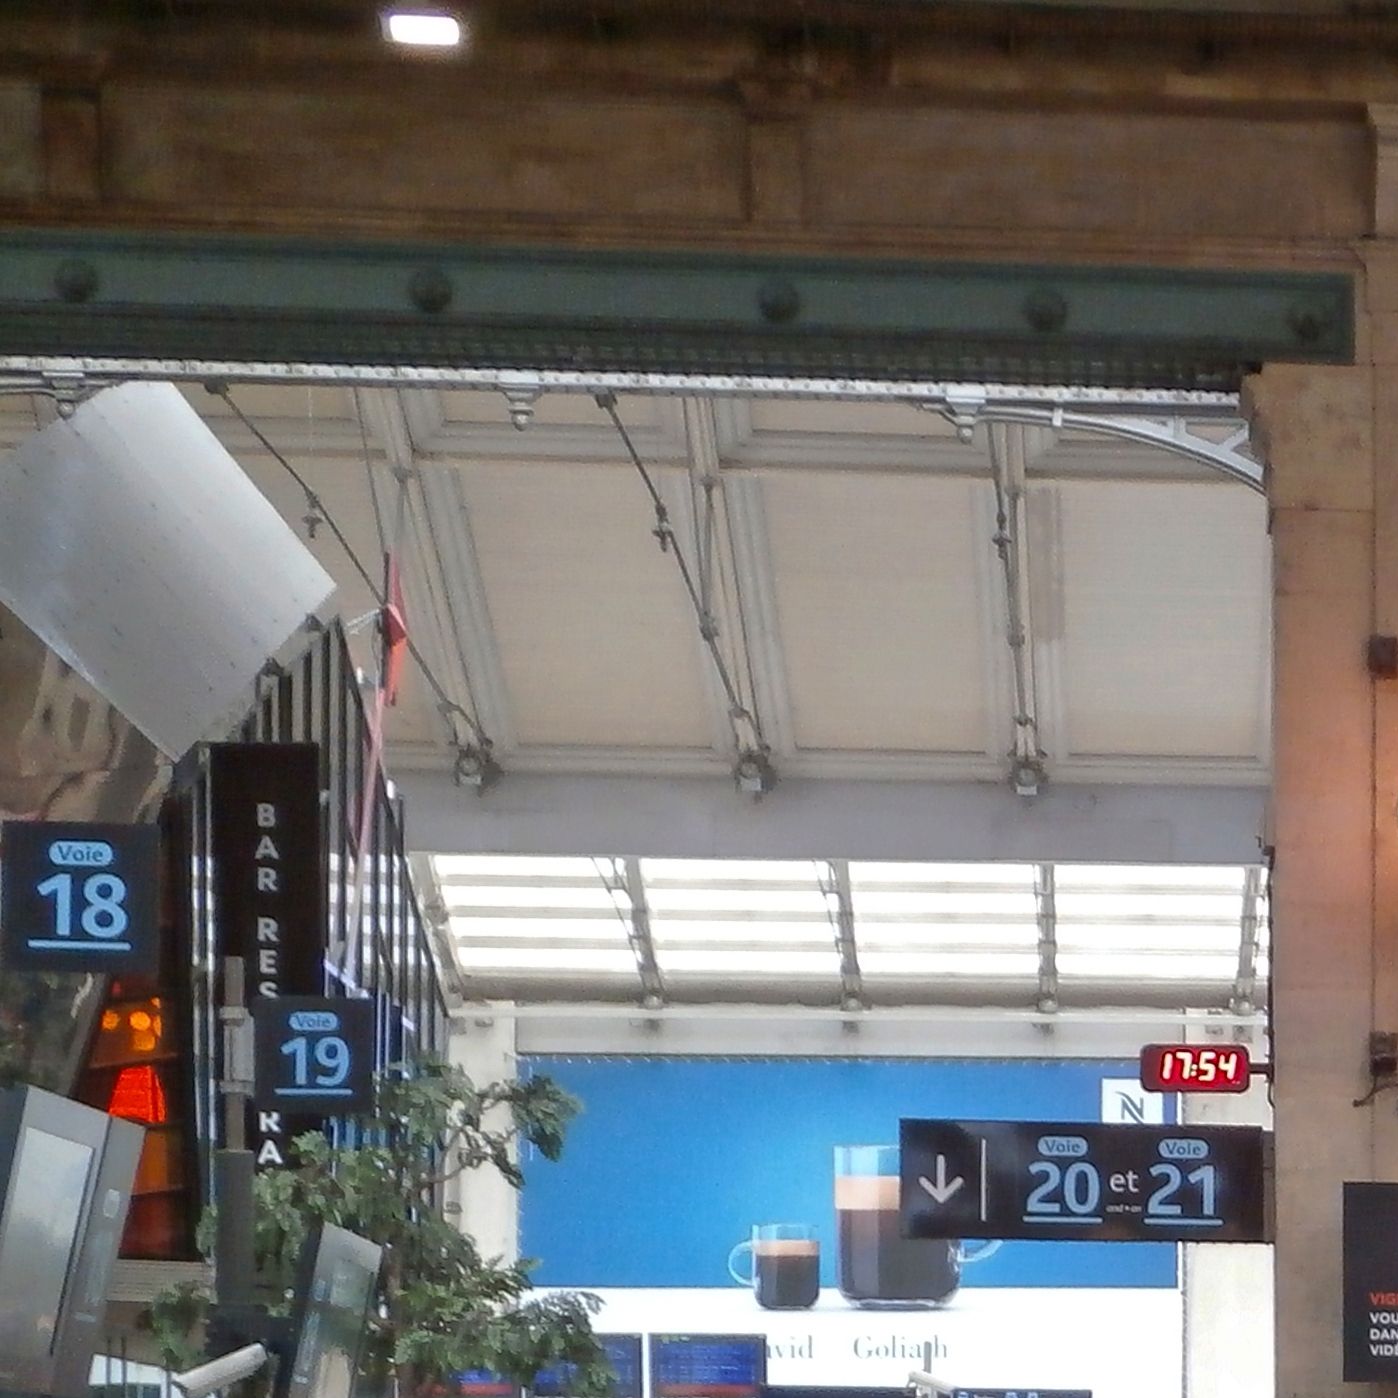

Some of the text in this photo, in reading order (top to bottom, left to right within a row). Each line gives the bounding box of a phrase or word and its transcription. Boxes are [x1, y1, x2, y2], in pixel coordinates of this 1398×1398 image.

[57, 844, 104, 863] Voie
[255, 802, 281, 893] BAR
[36, 872, 129, 939] 18
[292, 1013, 332, 1029] Voie
[280, 1035, 351, 1087] 19
[1161, 1050, 1239, 1082] 17:54
[1043, 1139, 1081, 1154] Voie
[1164, 1141, 1202, 1156] Voie
[1026, 1160, 1217, 1216] 20 et 21
